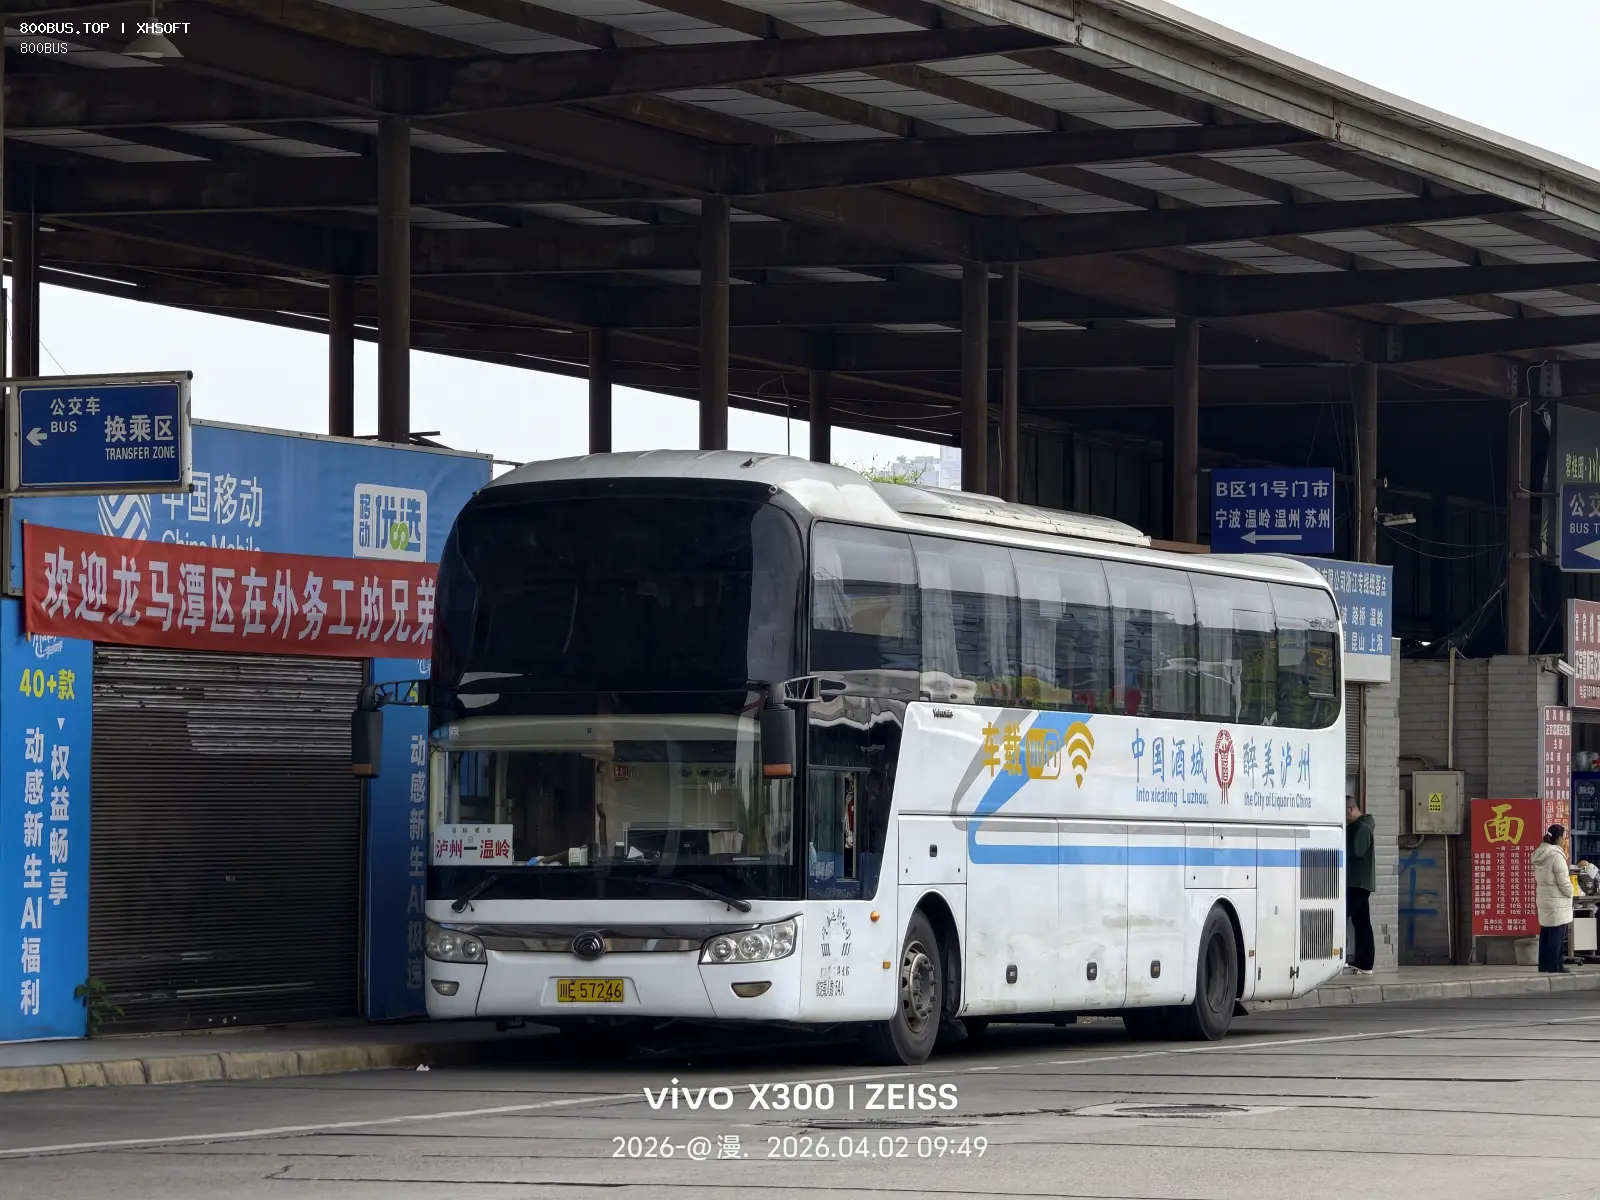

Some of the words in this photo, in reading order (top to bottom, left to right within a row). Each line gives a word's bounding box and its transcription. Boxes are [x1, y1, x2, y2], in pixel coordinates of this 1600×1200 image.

[50, 397, 101, 416] 公交车
[50, 420, 77, 433] BUS
[104, 415, 174, 443] 换乘区
[105, 447, 150, 460] TRANSFER
[152, 446, 175, 459] ZONE
[1216, 480, 1330, 497] B区11号门市
[1215, 509, 1241, 528] 宁波
[1245, 509, 1271, 528] 温岭
[1275, 509, 1300, 528] 温州
[1305, 508, 1330, 528] 苏州
[1570, 523, 1589, 534] BUS
[20, 668, 75, 700] 40+款
[981, 721, 1022, 778] 车载
[1131, 727, 1208, 785] 中国酒城
[1242, 736, 1311, 790] 醉美泸州
[1254, 792, 1265, 811] City
[1295, 793, 1312, 808] China
[48, 744, 70, 906] 权益畅享
[1484, 803, 1524, 844] 面
[21, 728, 44, 1015] 动感新生AI福利
